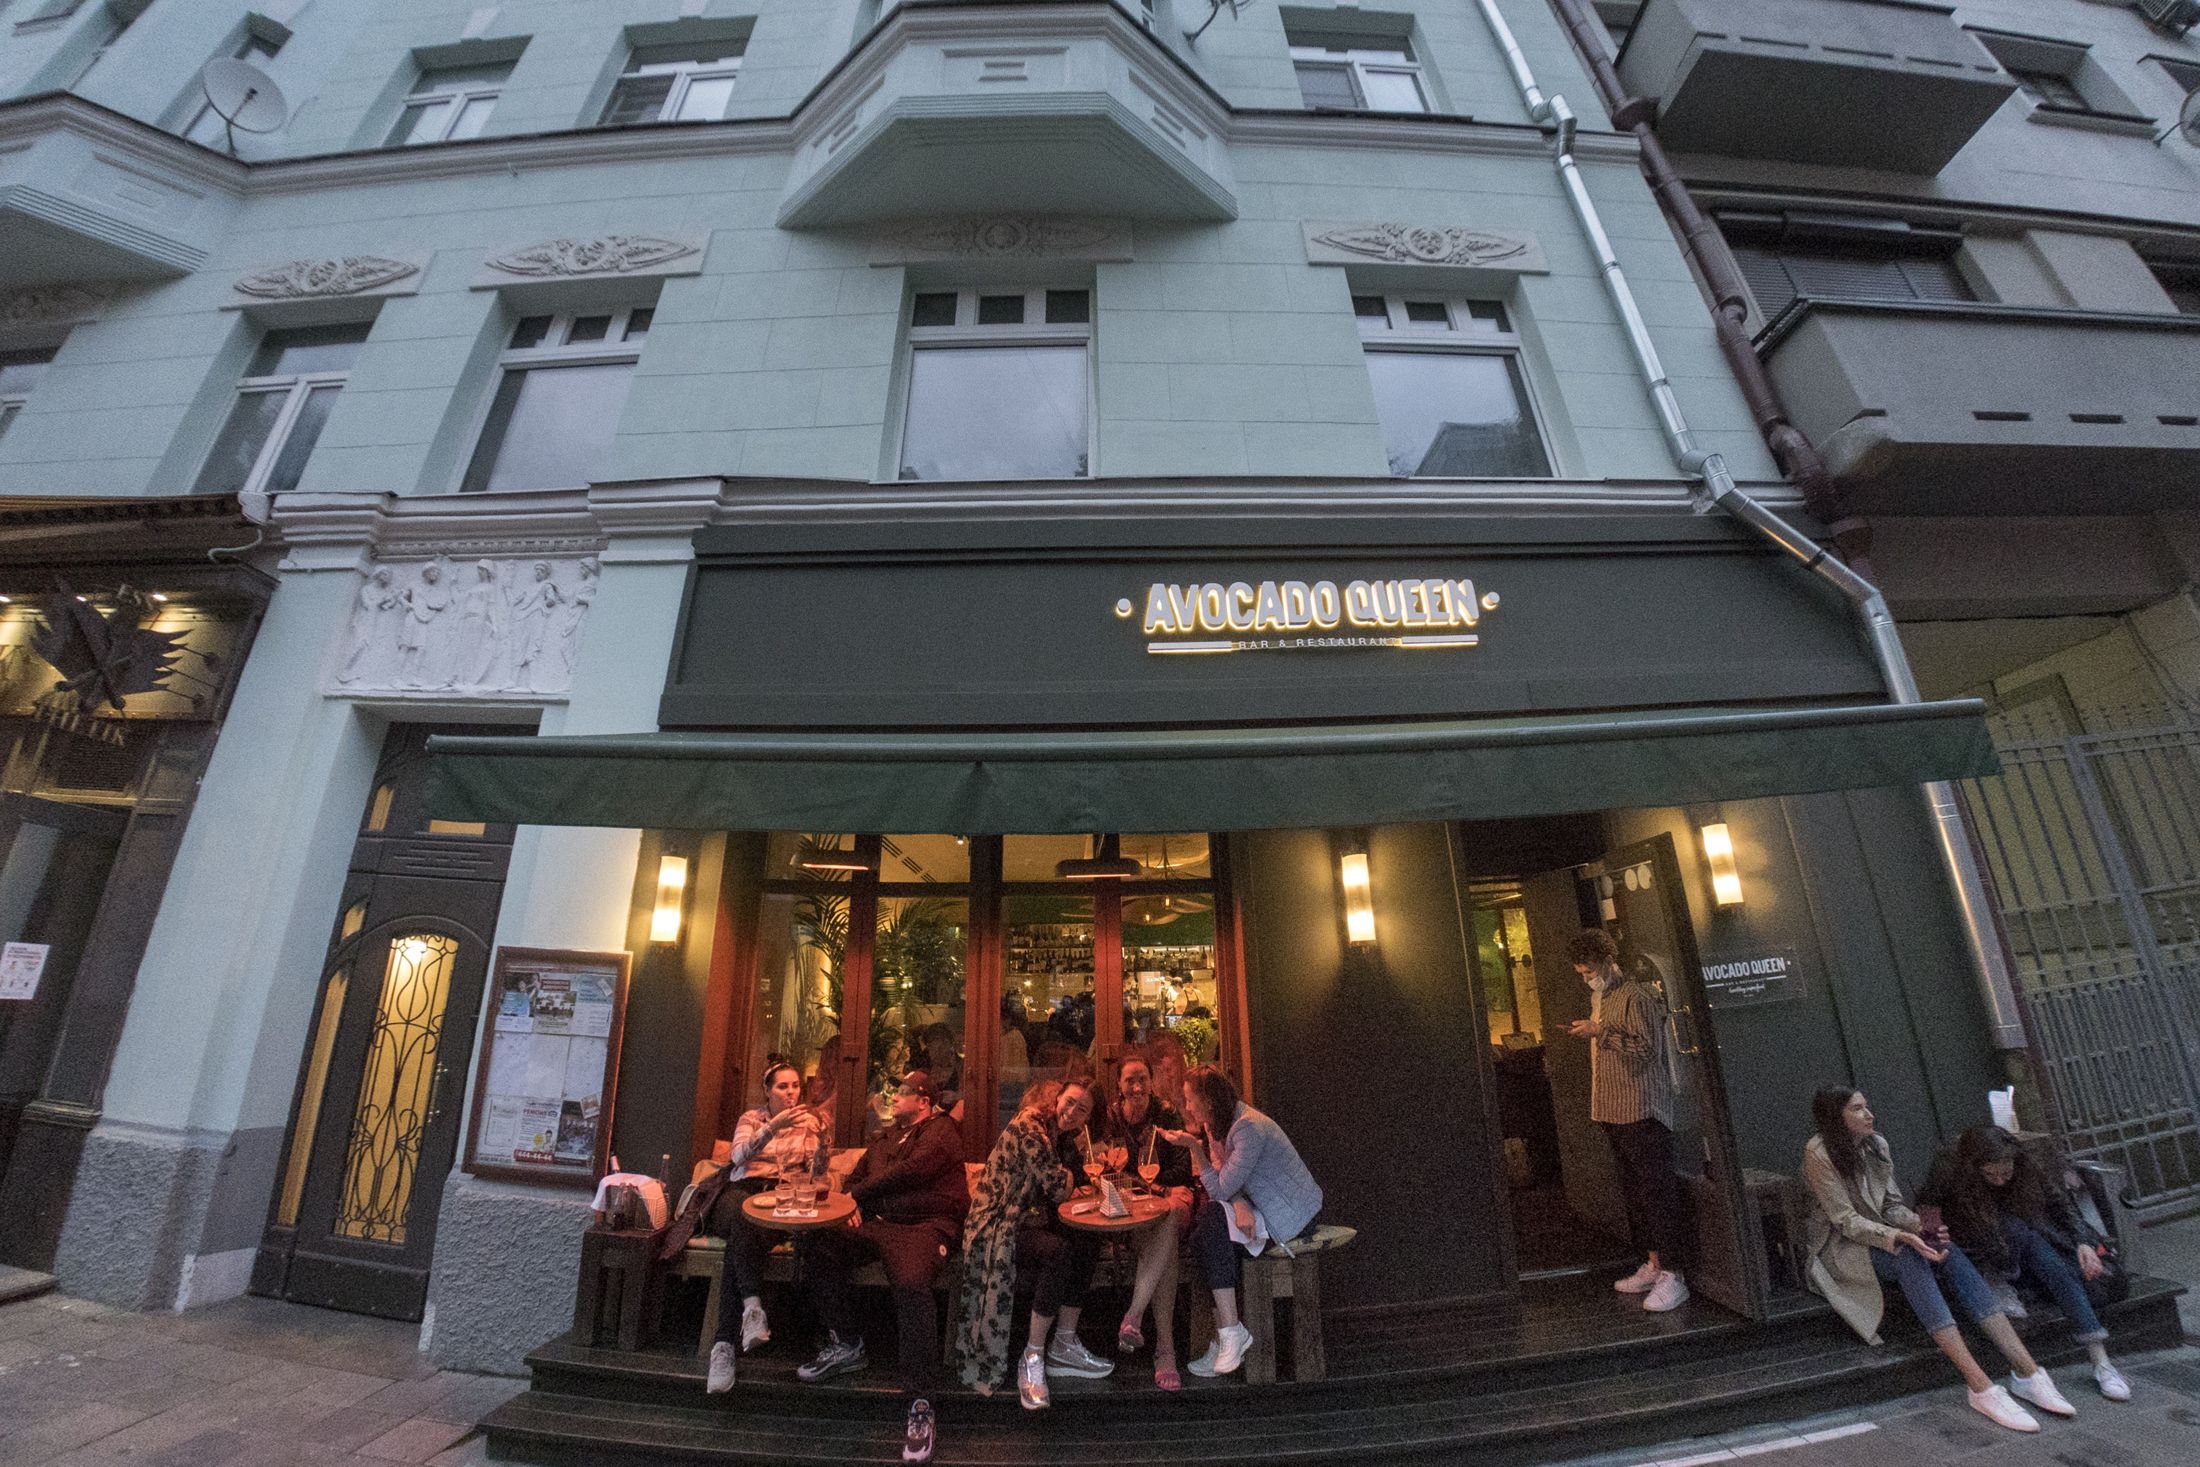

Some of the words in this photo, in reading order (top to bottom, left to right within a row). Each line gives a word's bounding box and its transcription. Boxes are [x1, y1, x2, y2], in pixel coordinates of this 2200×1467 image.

[1145, 580, 1341, 631] AVOCADO
[1346, 578, 1480, 625] QUEEN
[1238, 640, 1269, 650] BAR
[1279, 639, 1287, 648] &
[1296, 637, 1397, 648] RESTAURANT
[1751, 957, 1786, 975] QUEEN
